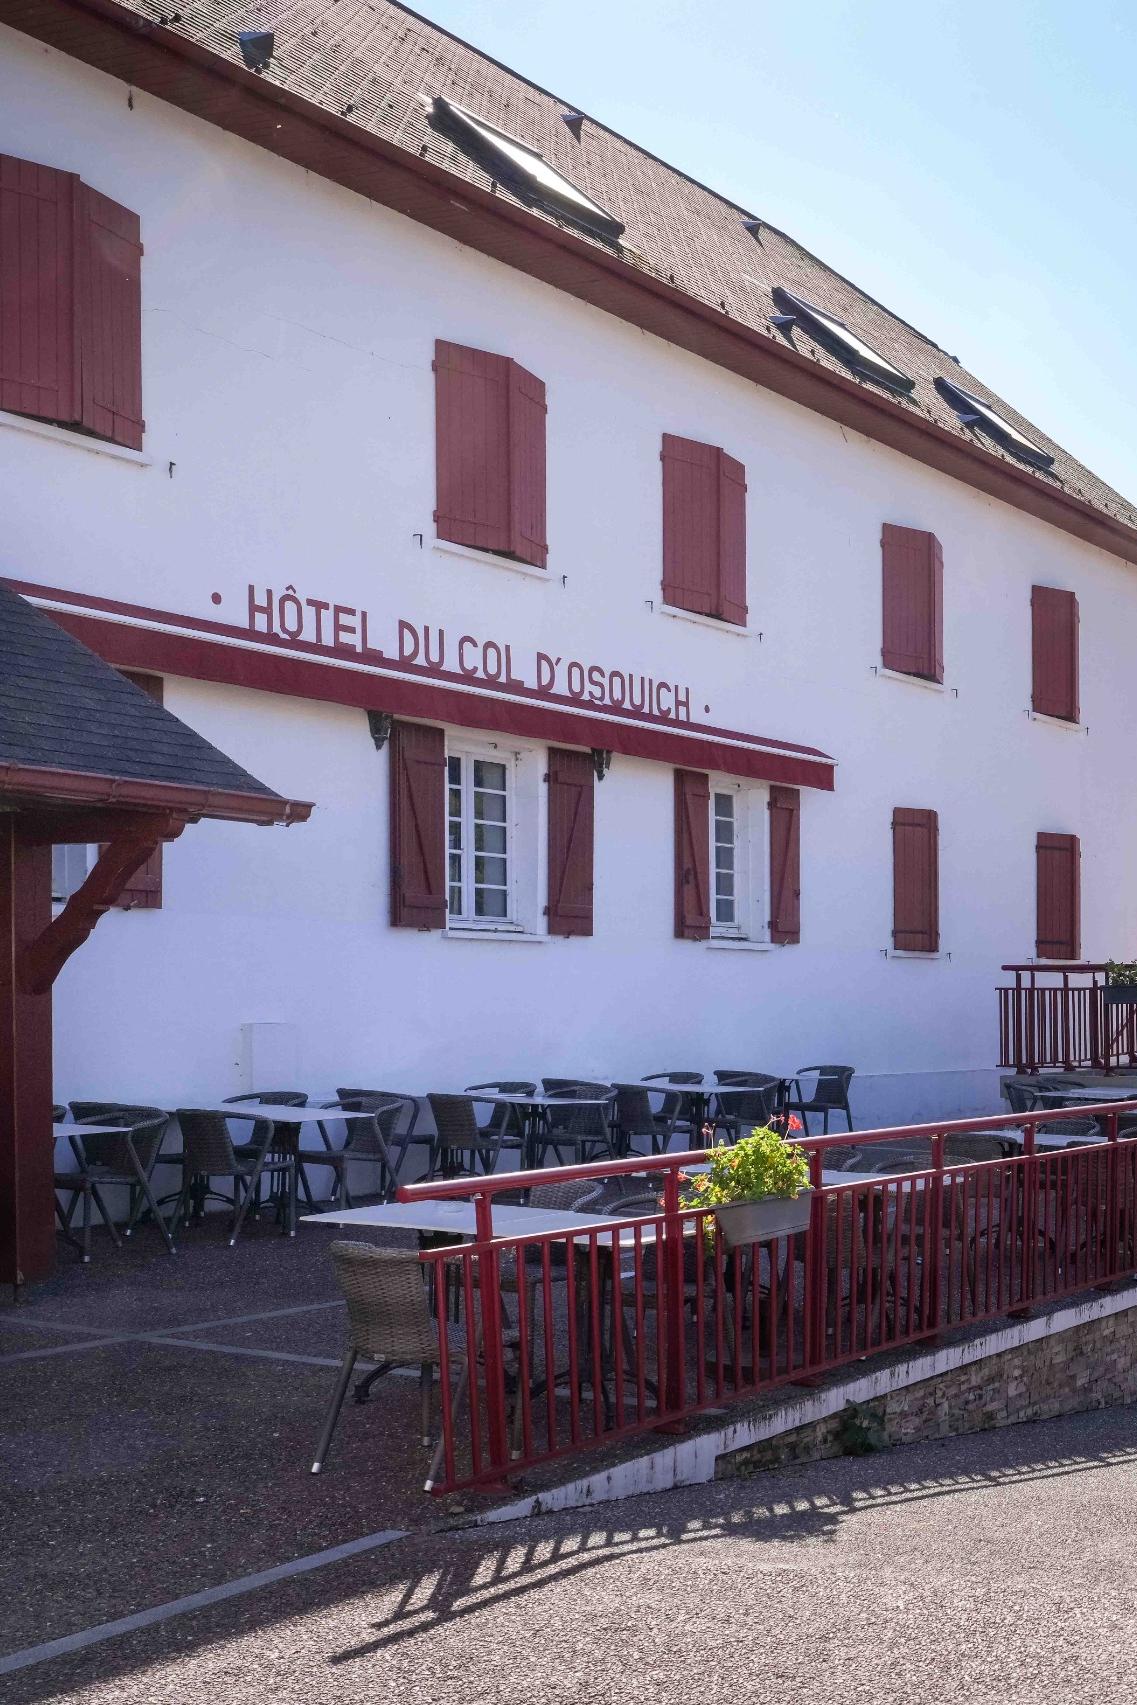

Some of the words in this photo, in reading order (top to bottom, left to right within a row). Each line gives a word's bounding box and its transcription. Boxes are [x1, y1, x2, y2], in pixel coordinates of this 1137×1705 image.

[248, 584, 384, 657] HÔTEL
[398, 619, 445, 670] DU
[458, 635, 525, 688] COL
[536, 651, 690, 722] D'OSQUICH
